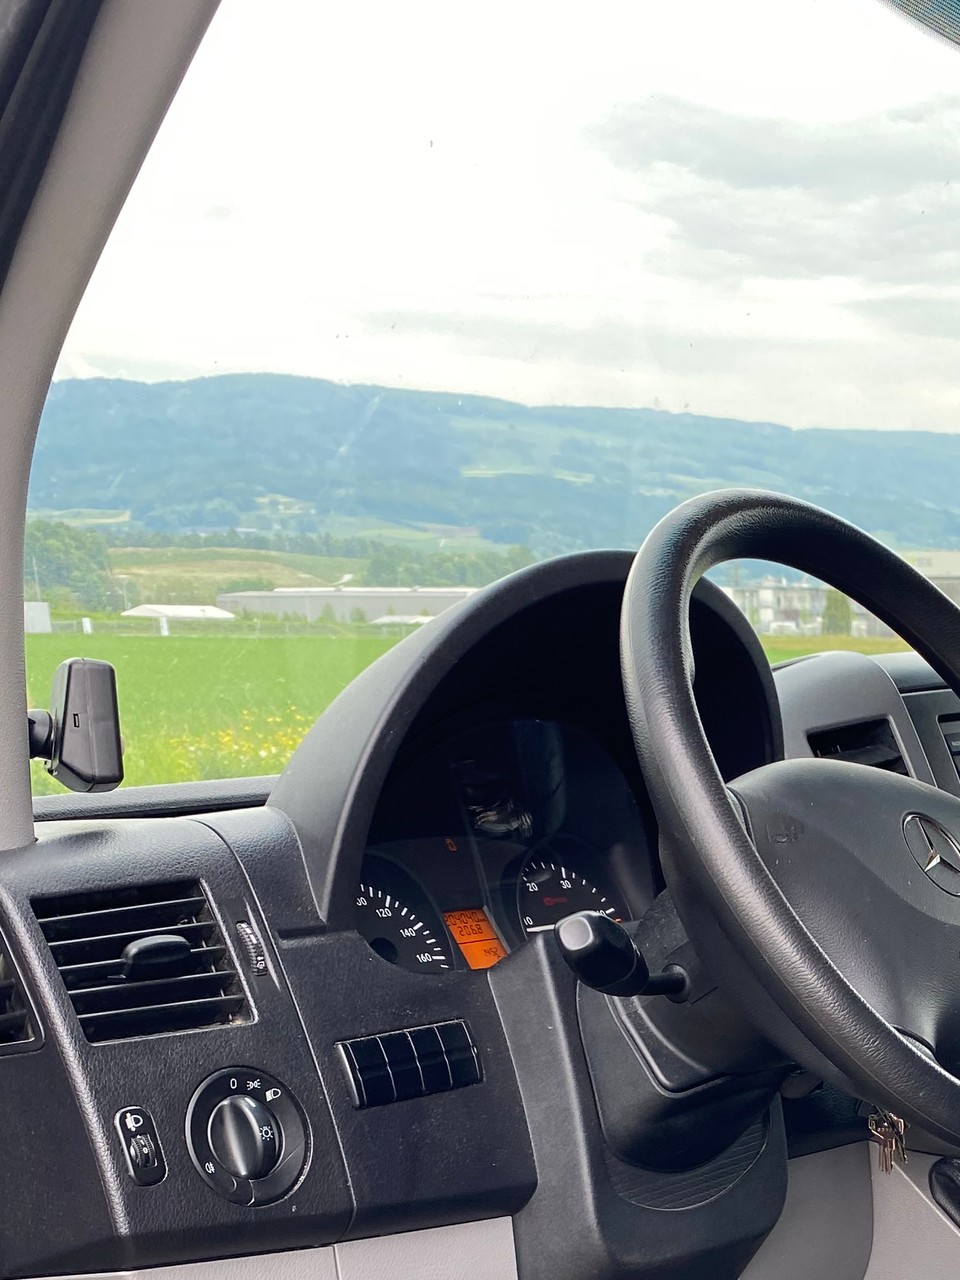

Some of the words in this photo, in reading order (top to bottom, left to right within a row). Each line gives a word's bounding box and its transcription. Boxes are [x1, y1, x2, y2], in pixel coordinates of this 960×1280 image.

[526, 882, 538, 892] 20
[560, 880, 572, 889] 30
[375, 908, 392, 918] 120
[523, 916, 533, 926] 10
[400, 927, 416, 938] 140
[416, 954, 433, 963] 160
[230, 1078, 237, 1089] 0
